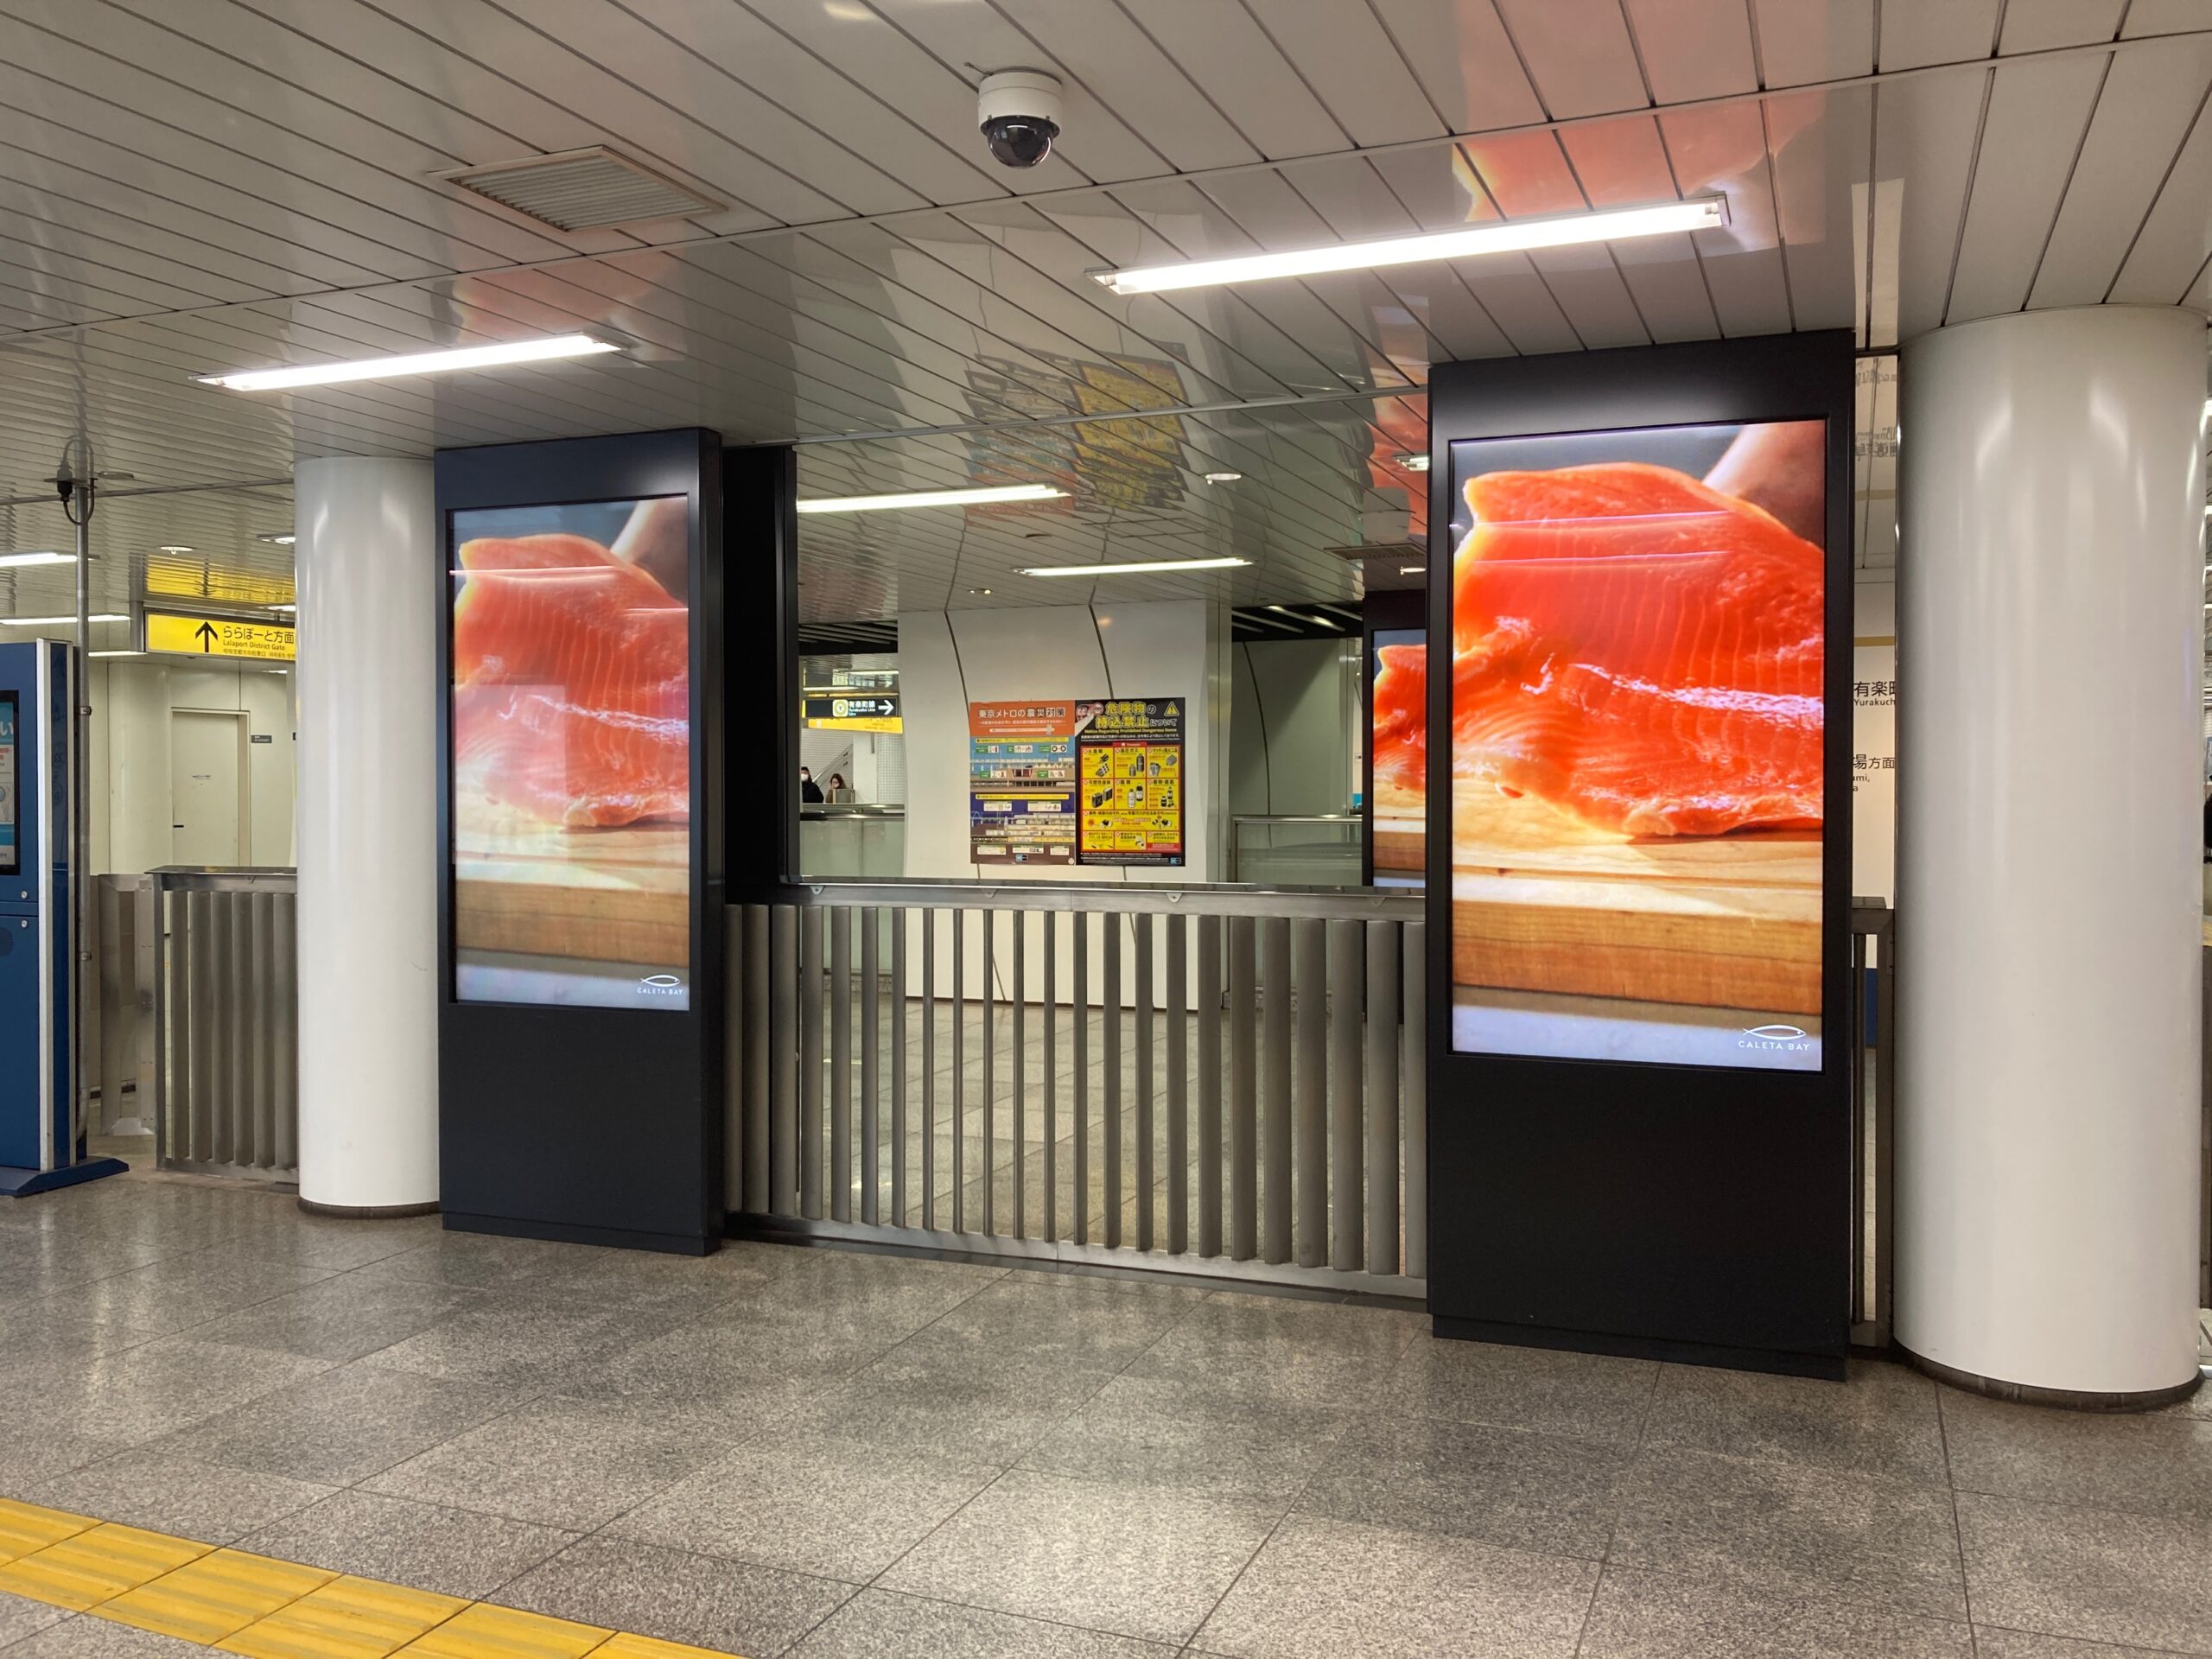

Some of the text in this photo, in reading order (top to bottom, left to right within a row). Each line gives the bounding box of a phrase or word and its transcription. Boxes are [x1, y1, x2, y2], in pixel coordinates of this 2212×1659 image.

[223, 626, 295, 645] ららぽーと方面
[1738, 1040, 1810, 1051] CALETA BAY
